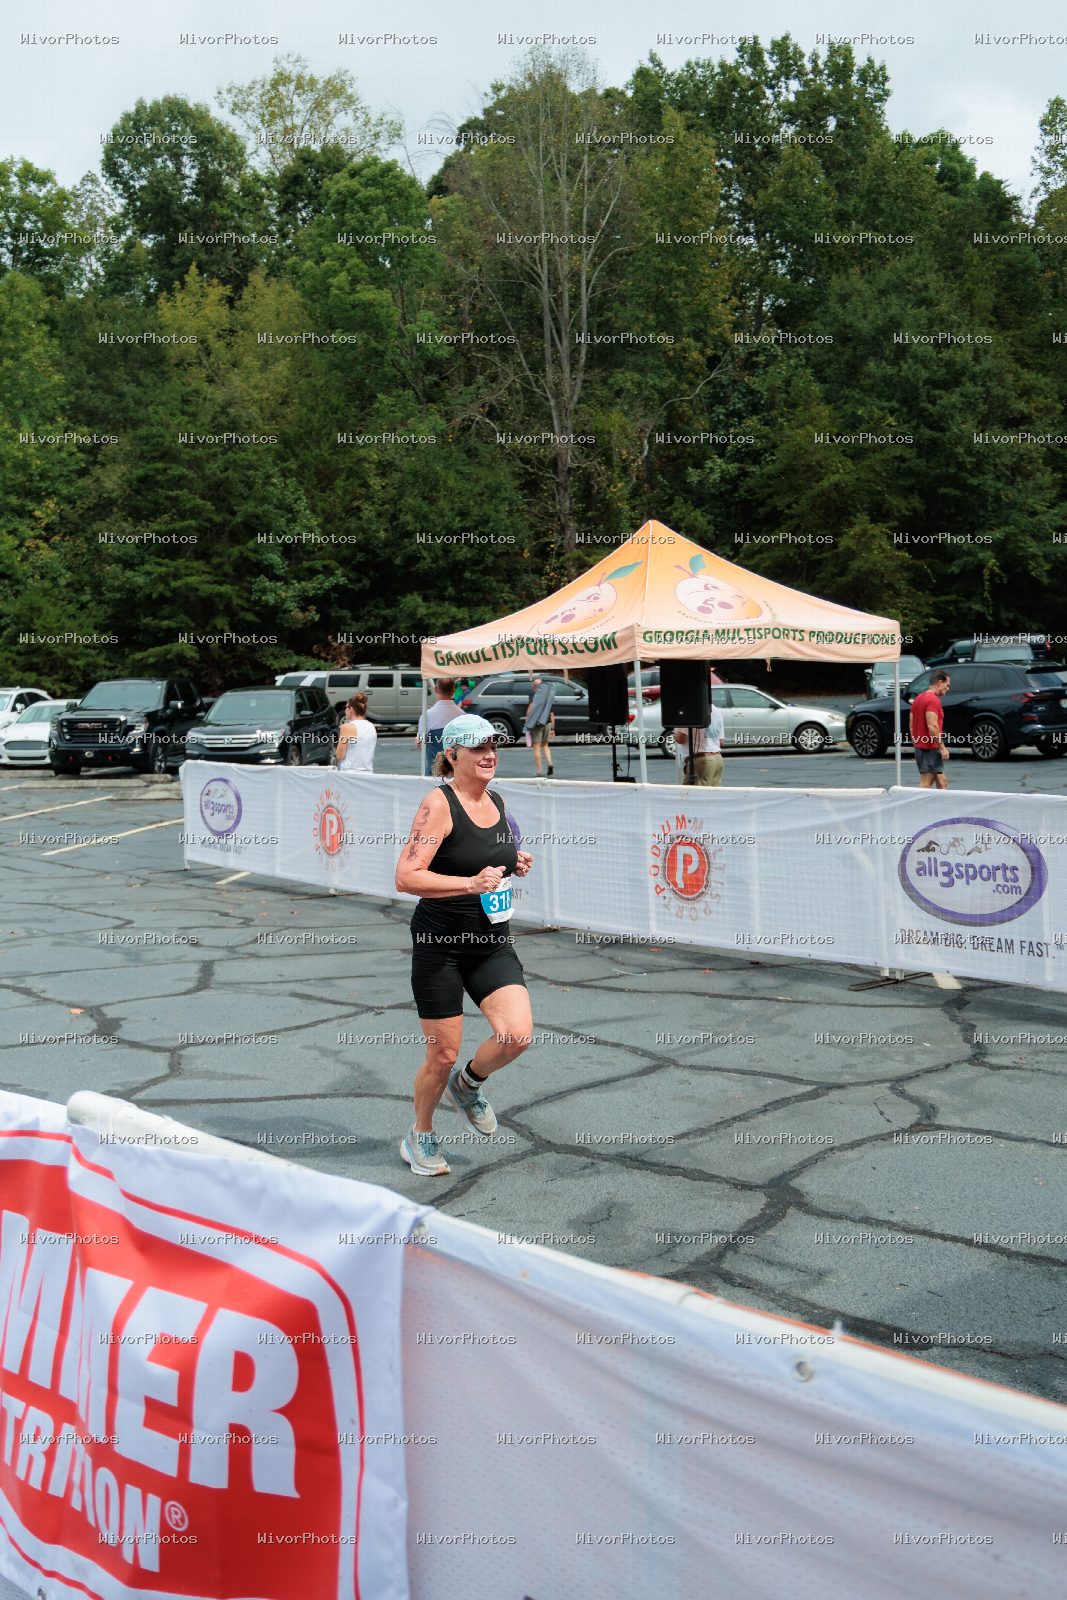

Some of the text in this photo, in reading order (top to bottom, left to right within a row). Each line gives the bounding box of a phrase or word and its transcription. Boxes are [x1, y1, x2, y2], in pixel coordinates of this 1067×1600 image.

[675, 845, 700, 889] P
[915, 857, 1020, 888] all3sports
[992, 884, 1022, 896] .com
